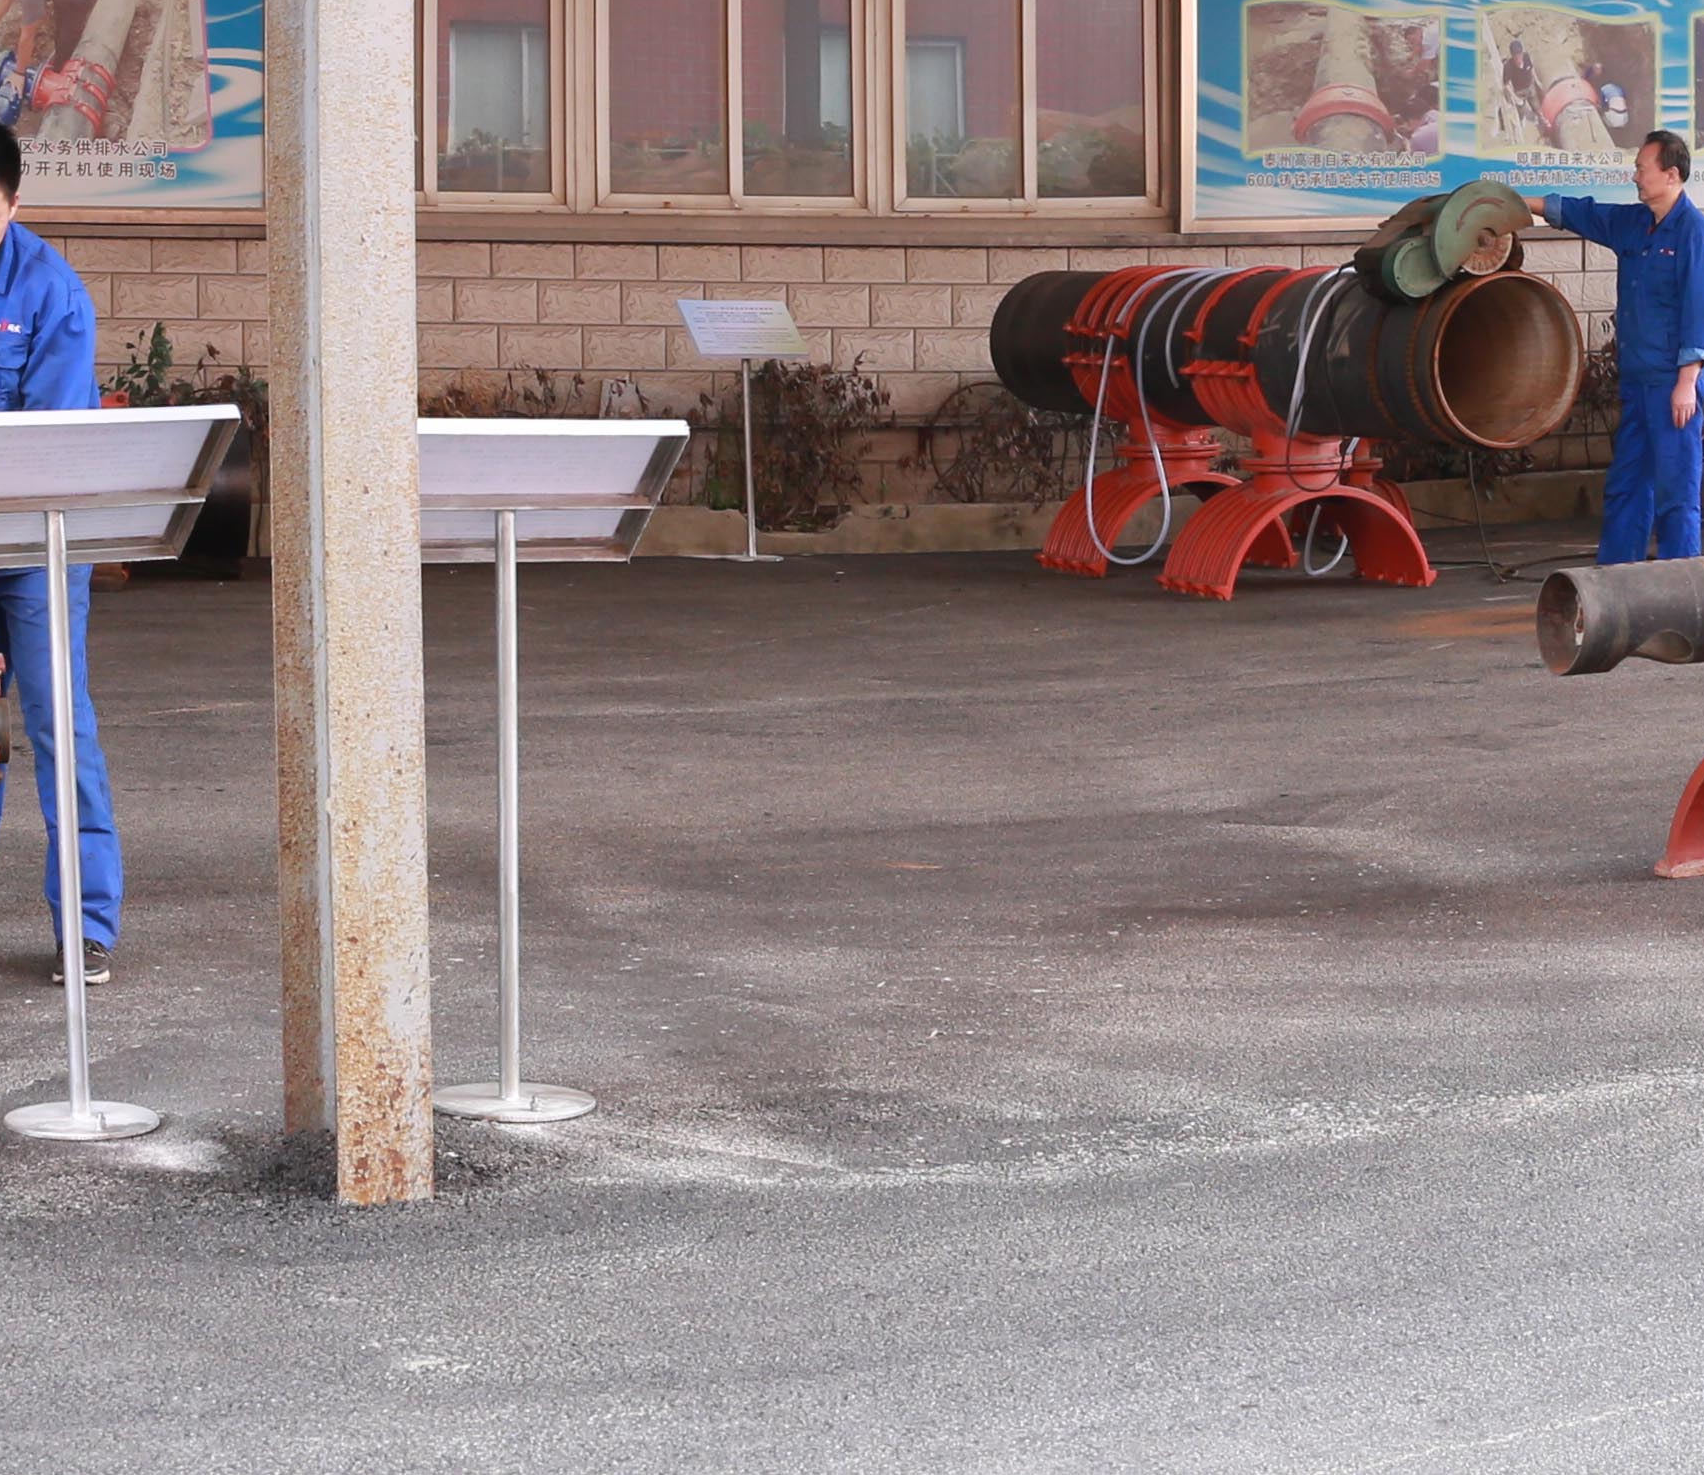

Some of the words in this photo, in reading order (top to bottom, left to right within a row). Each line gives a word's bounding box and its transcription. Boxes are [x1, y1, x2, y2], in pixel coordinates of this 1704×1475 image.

[1263, 151, 1427, 168] 泰州高港自来水有限公司
[1516, 150, 1624, 167] 即墨市自来水公司
[1277, 170, 1441, 189] 铸铁承插哈夫节使用现场
